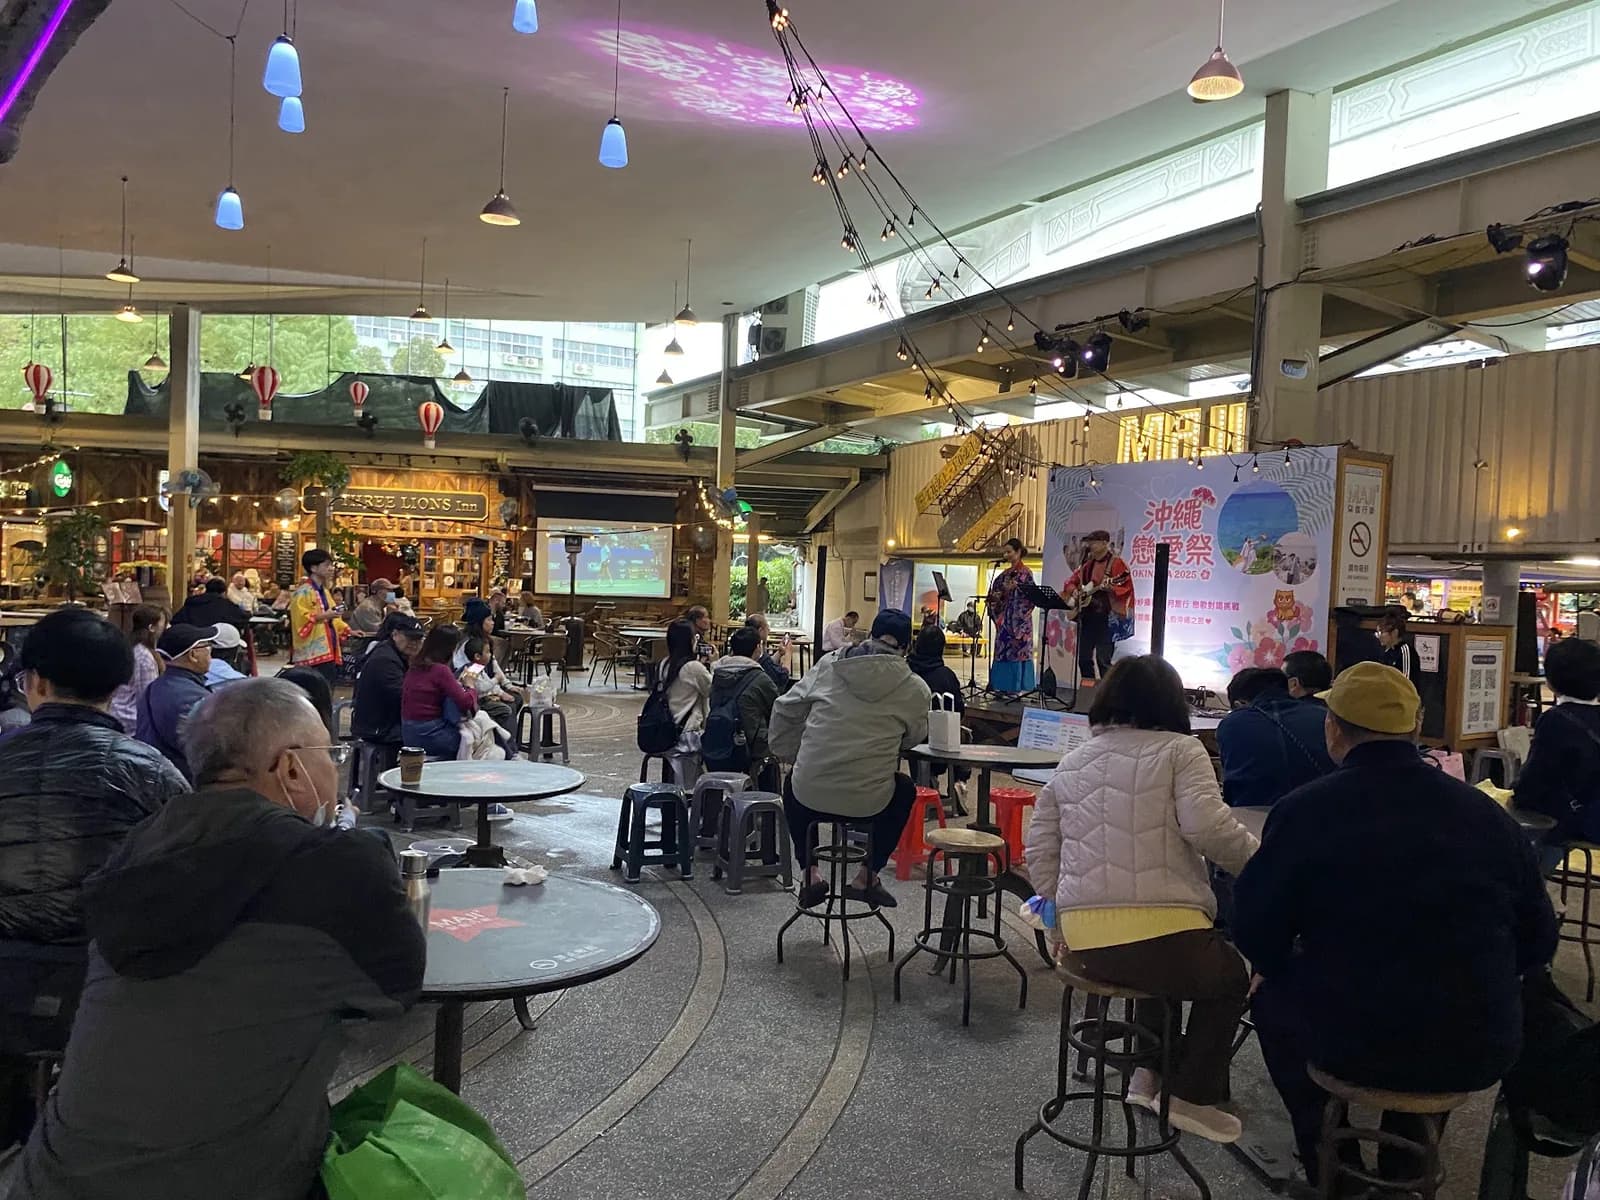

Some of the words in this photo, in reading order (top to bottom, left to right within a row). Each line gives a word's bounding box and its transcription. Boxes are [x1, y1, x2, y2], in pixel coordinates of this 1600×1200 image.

[341, 494, 396, 510] THREE
[400, 496, 452, 511] LIONS
[456, 500, 478, 512] Inn
[1142, 499, 1202, 532] 沖繩
[1129, 533, 1214, 566] 戀愛祭
[1132, 569, 1174, 579] OKINA
[1174, 570, 1197, 580] 2025
